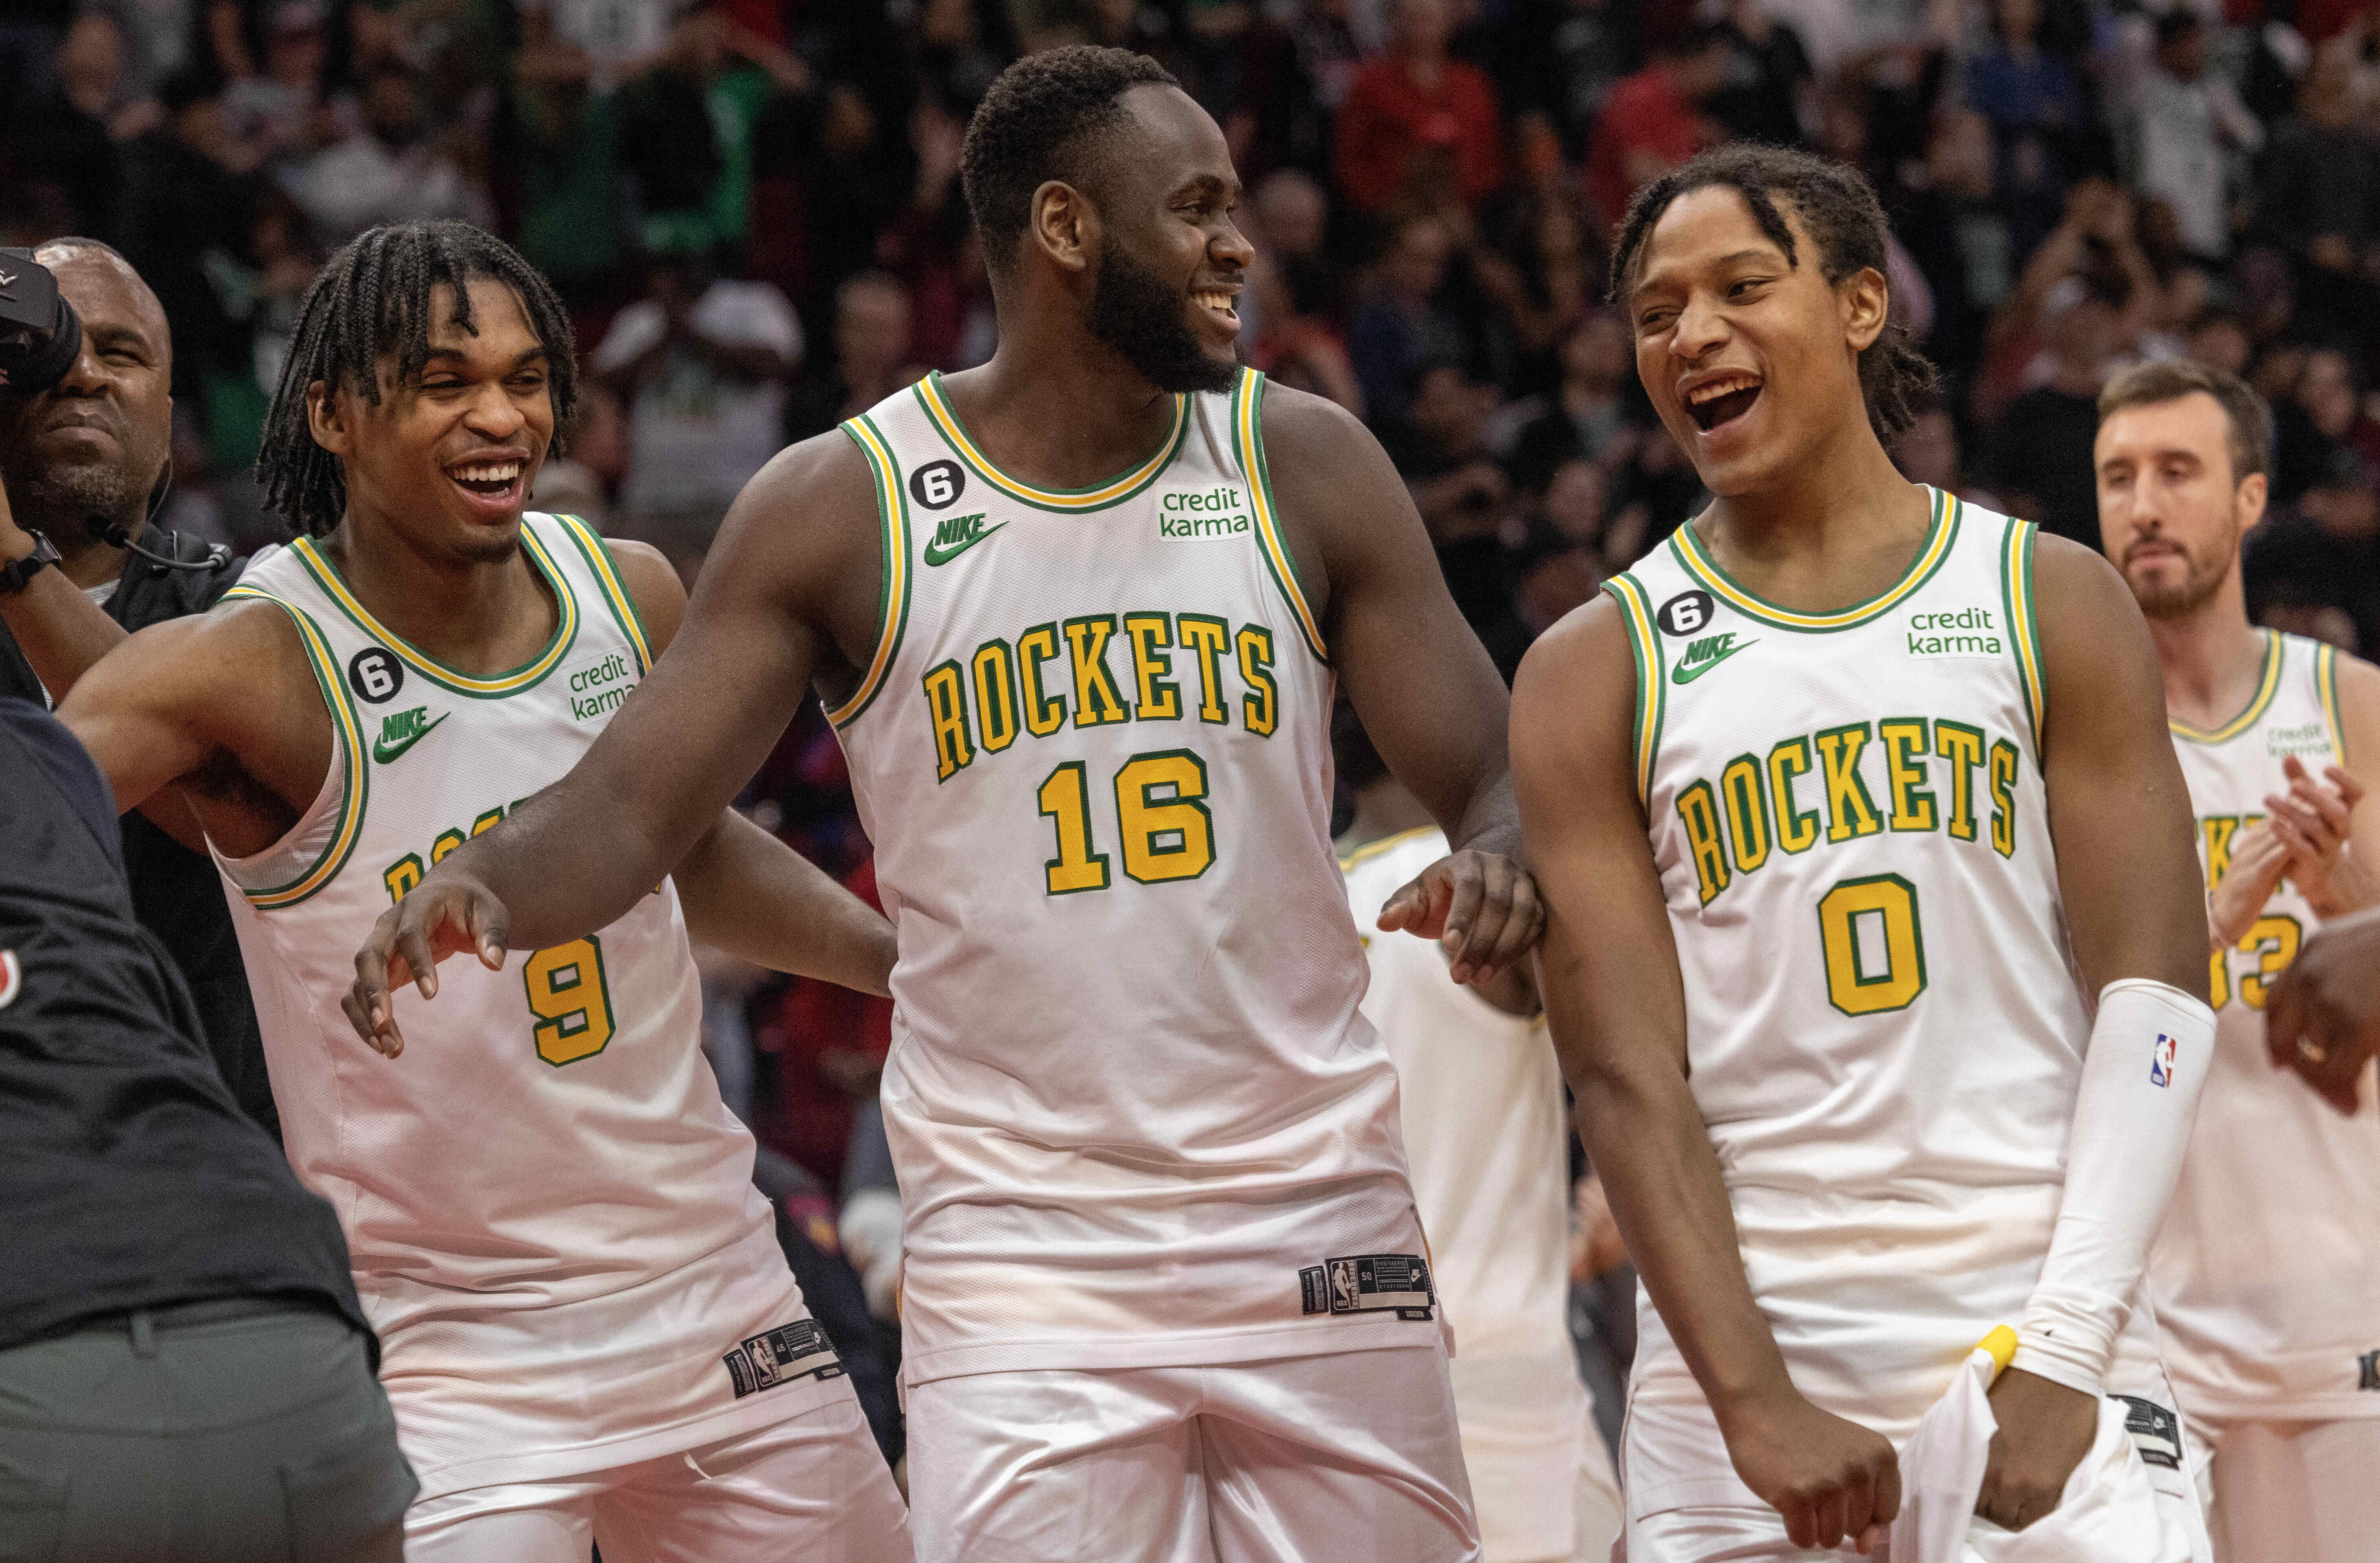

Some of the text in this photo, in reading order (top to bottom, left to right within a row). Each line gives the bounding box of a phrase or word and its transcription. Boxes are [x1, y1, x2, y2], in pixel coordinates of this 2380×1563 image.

[922, 467, 954, 504] 6
[1164, 488, 1241, 511] credit
[935, 513, 986, 546] NIKE
[1160, 513, 1249, 537] karma
[1671, 597, 1703, 632] 6
[1911, 608, 1994, 630] credit
[1683, 632, 1736, 665] NIKE
[1908, 632, 2001, 654] karma
[358, 655, 393, 697] 6
[570, 654, 628, 692] credit
[922, 612, 1279, 785] ROCKETS
[382, 706, 427, 743] NIKE
[1037, 748, 1217, 896] 16
[1675, 717, 2019, 909] ROCKETS
[1817, 872, 1927, 1017] 0
[522, 934, 616, 1067] 9
[1361, 1272, 1373, 1281] 50
